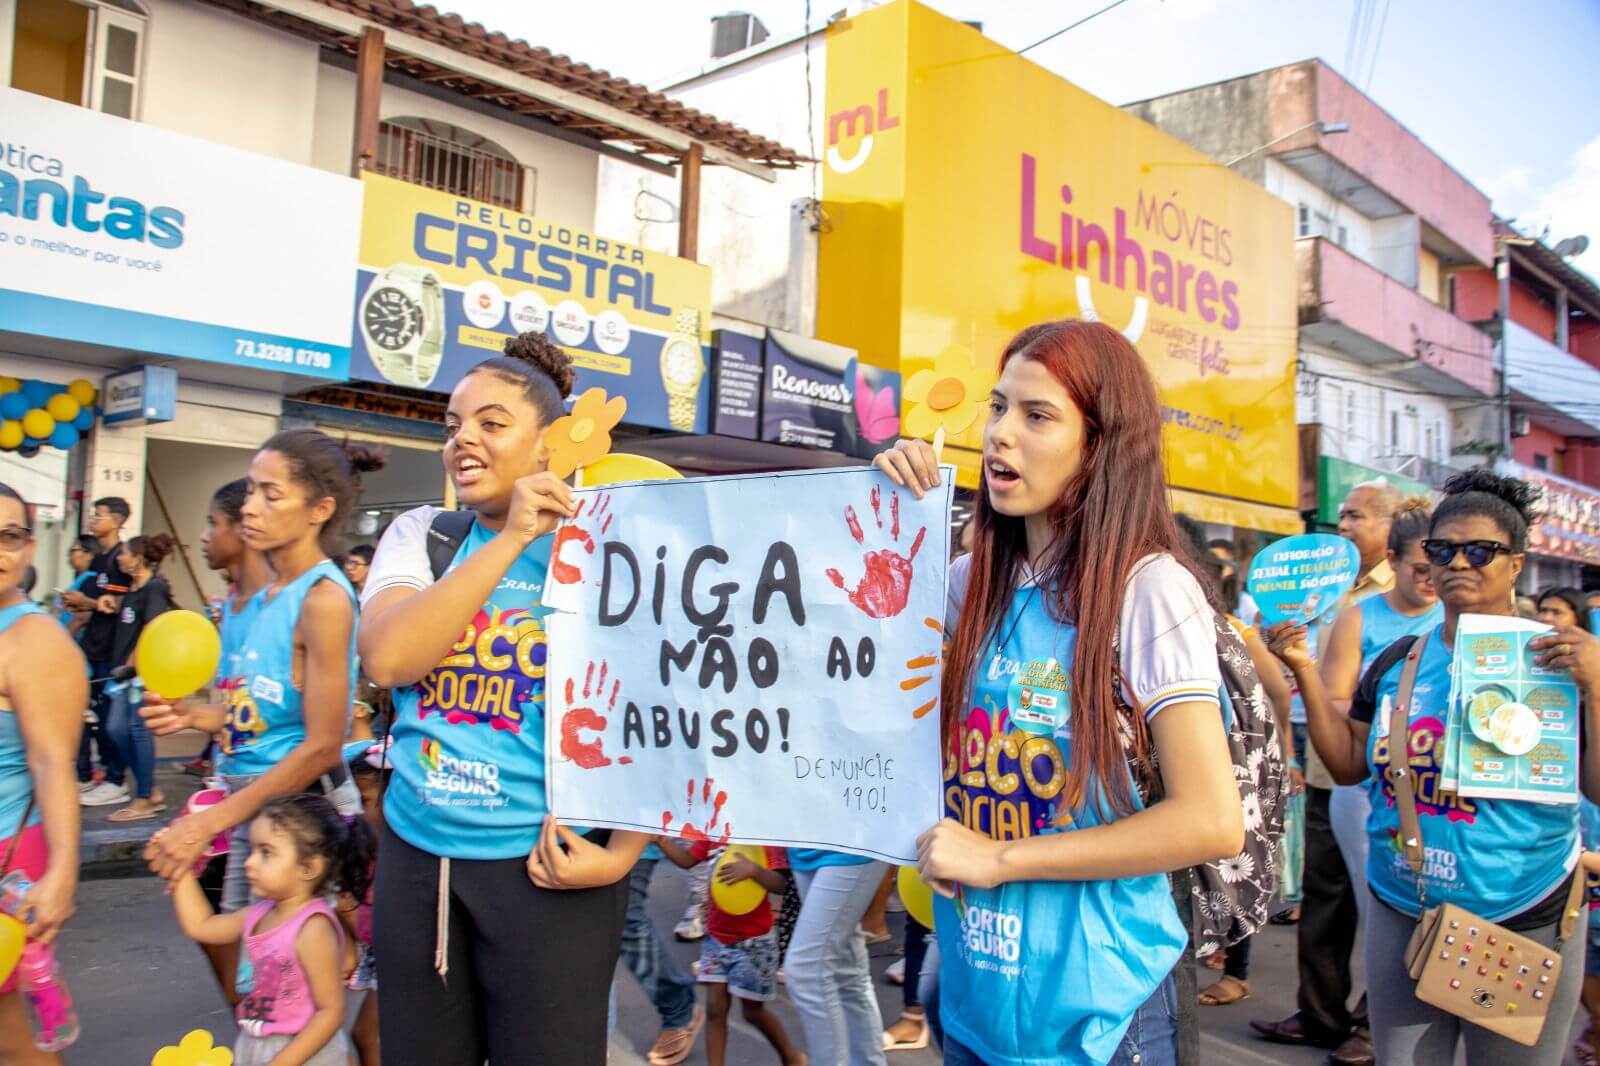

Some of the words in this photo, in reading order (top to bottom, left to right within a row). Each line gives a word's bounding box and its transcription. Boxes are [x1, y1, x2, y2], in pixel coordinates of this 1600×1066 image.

[31, 238, 90, 258] melhor
[94, 250, 121, 264] por
[456, 201, 645, 265] RELOJOARIA
[1020, 152, 1241, 331] Linhares
[1135, 191, 1233, 267] MÓVEIS
[413, 212, 672, 316] CRISTAL
[103, 468, 135, 482] 119
[659, 624, 779, 694] NÃO
[826, 635, 876, 681] AO
[422, 670, 521, 720] SOCIAL
[623, 702, 790, 758] ABUSO!
[424, 771, 501, 795] SEGURO
[437, 754, 499, 780] PORTO
[842, 787, 886, 814] 190!
[967, 905, 1021, 939] ORTO
